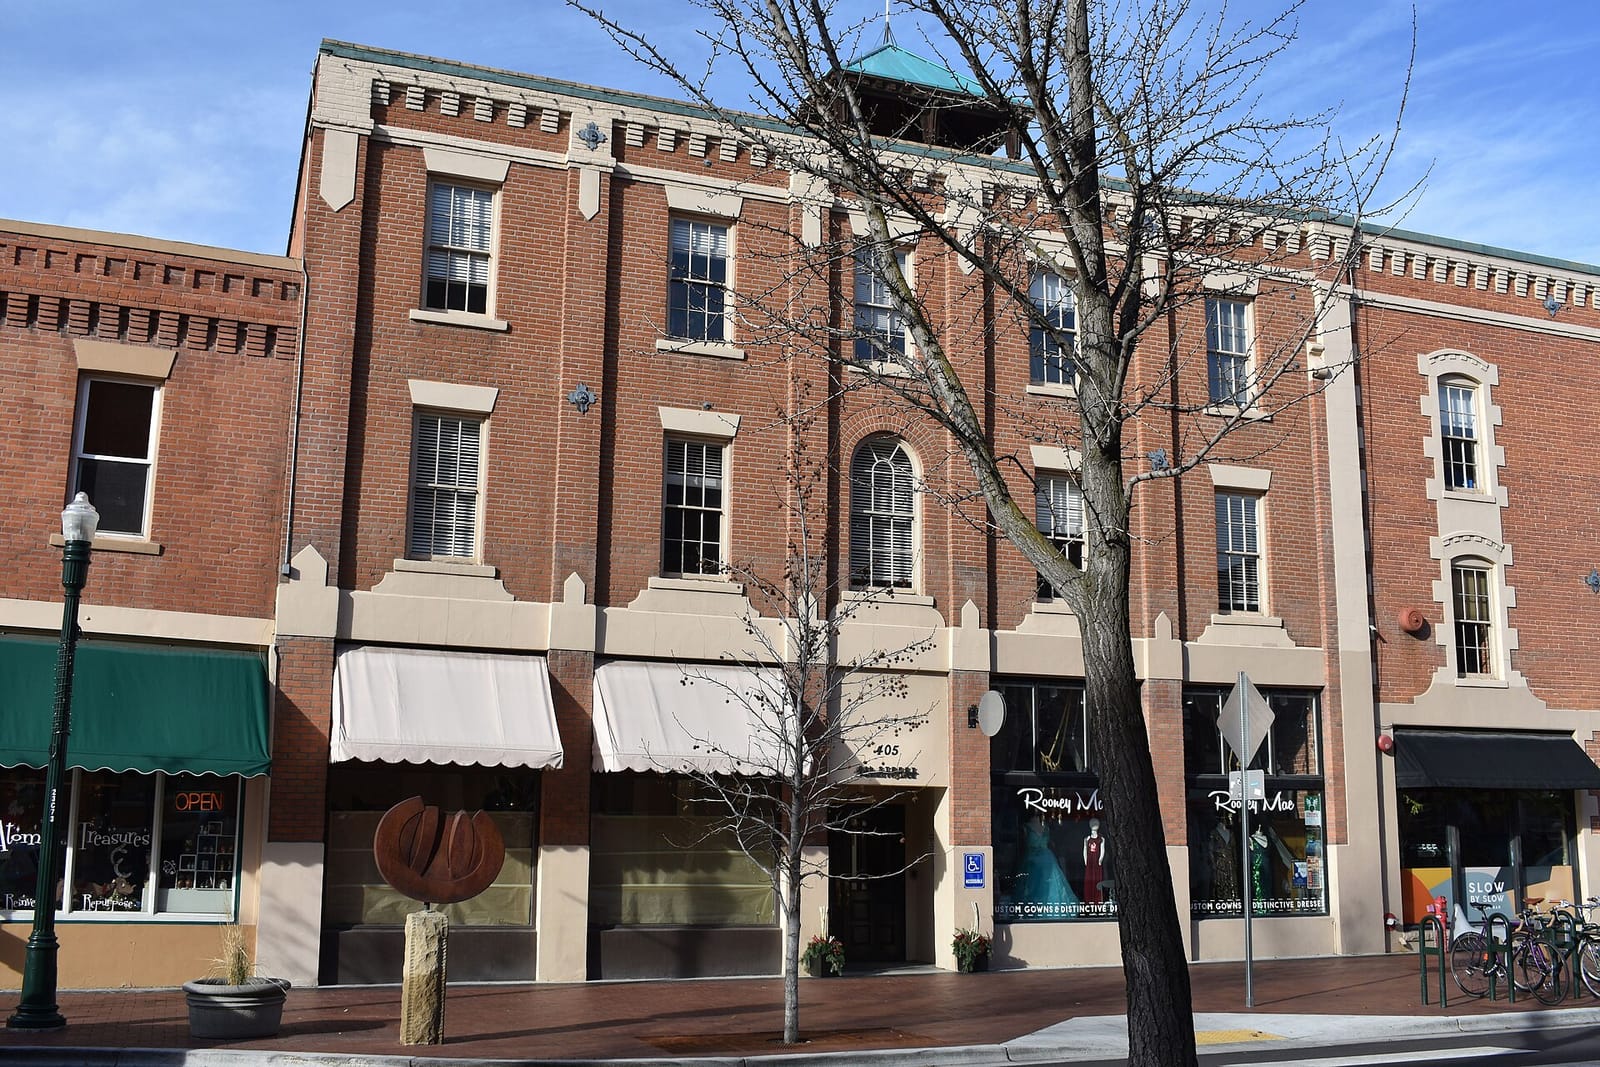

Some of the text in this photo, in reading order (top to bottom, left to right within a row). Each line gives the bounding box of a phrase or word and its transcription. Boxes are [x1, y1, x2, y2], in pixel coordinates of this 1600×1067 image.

[873, 744, 899, 755] 405
[175, 792, 224, 811] OPEN
[1017, 787, 1104, 814] Rooney Ma
[1207, 790, 1295, 814] Rooey Mae
[0, 819, 150, 852] Atom Treasures
[1468, 881, 1505, 893] SLOW
[1470, 894, 1504, 903] BY SLOW
[994, 904, 1021, 914] USTOM
[1024, 904, 1054, 914] GOWNS
[1060, 903, 1107, 914] DISTINCTIVE
[1190, 902, 1213, 910] USTOM
[1215, 902, 1242, 910] GOWNS
[1252, 900, 1295, 909] DISTINCTIVE
